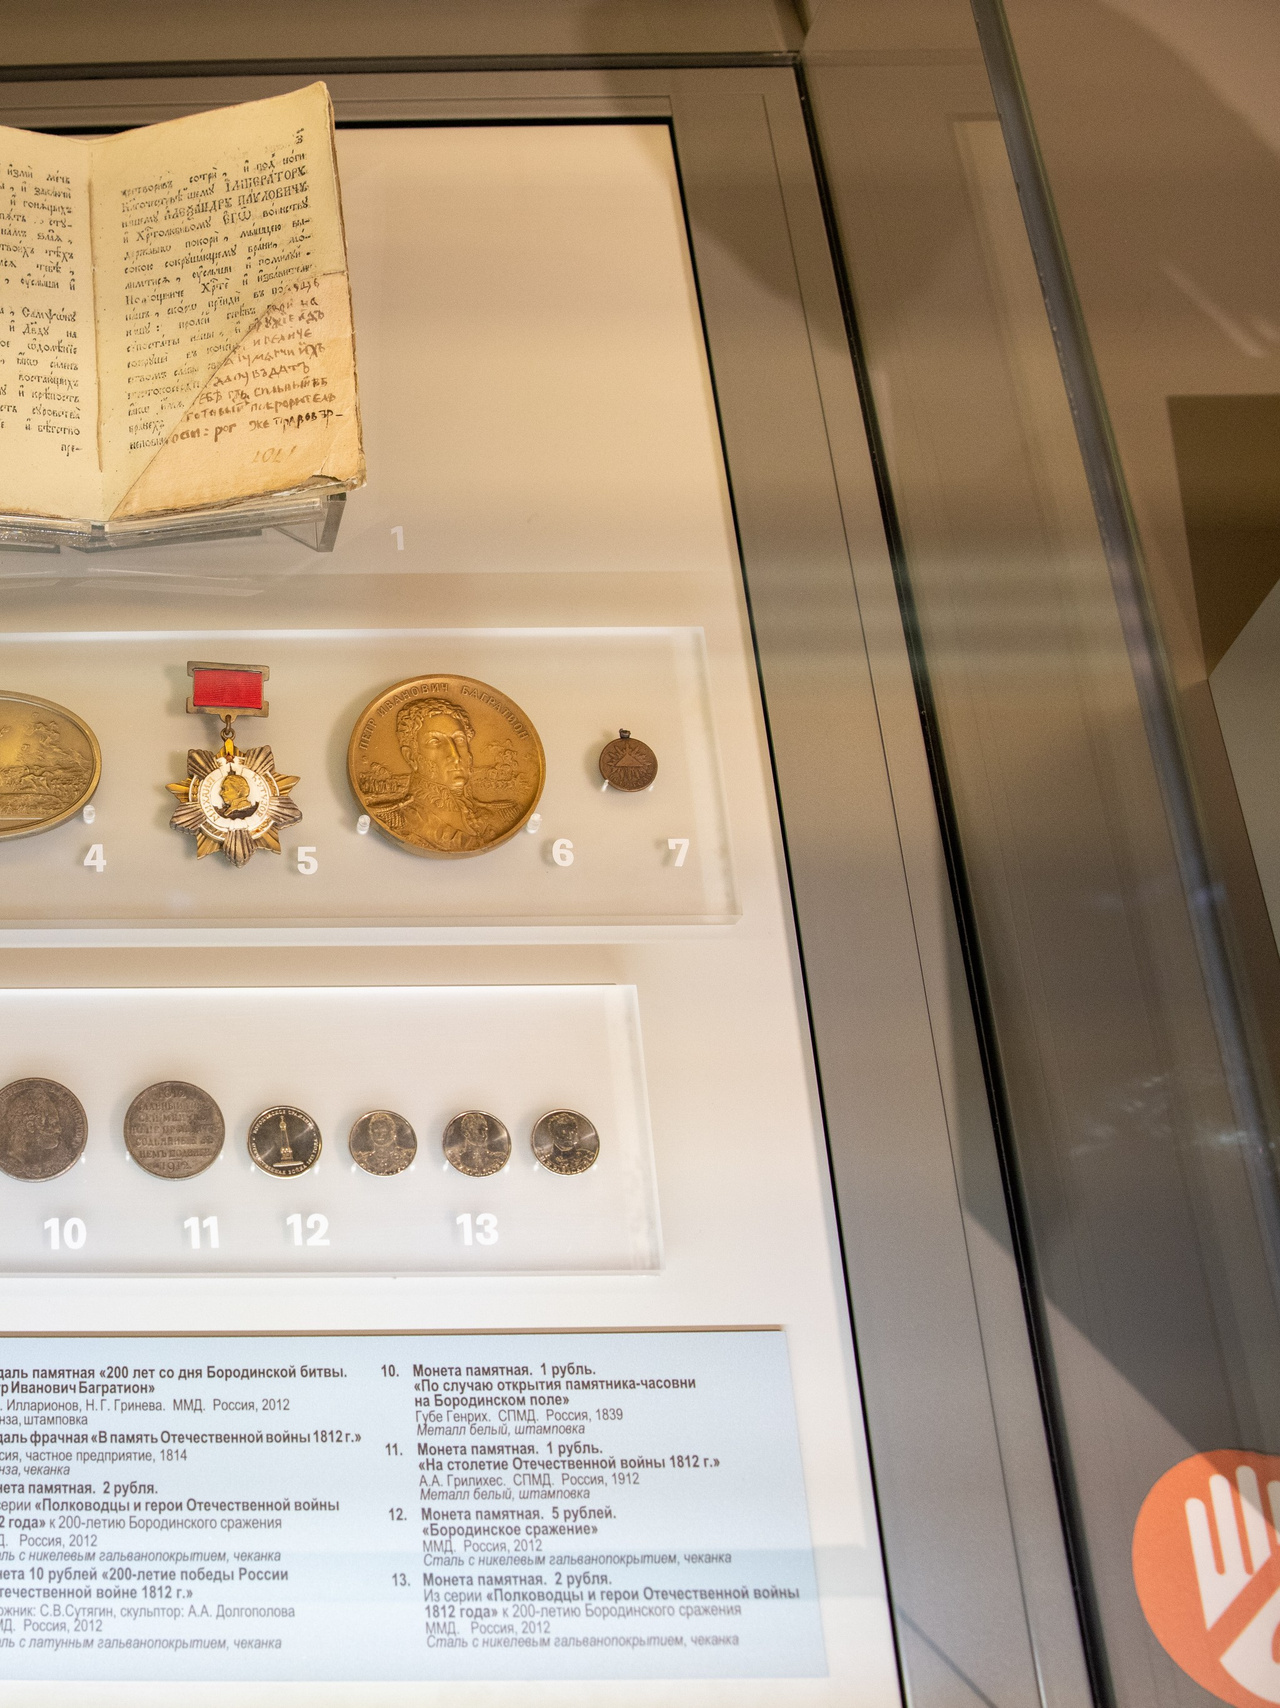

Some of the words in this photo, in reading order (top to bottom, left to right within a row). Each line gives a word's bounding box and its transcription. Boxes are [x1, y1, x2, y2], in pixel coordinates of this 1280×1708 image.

[391, 526, 404, 550] 1
[359, 718, 377, 750] ПЕТР
[378, 682, 449, 717] ИВАНОВИЧ
[461, 685, 529, 741] БАГРАТИОН
[84, 844, 106, 872] 4
[298, 847, 318, 874] 5
[553, 839, 574, 866] 6
[668, 839, 689, 866] 7
[45, 1218, 86, 1249] 10
[184, 1216, 219, 1249] 11
[287, 1214, 330, 1246] 12
[457, 1213, 498, 1245] 13
[32, 1368, 95, 1379] памятная
[99, 1365, 129, 1379] «200
[132, 1368, 156, 1379] лет
[158, 1368, 175, 1379] со
[177, 1368, 203, 1381] дня
[206, 1365, 297, 1382] Бородинской
[300, 1364, 347, 1378] битвы.
[381, 1364, 400, 1378] 10.
[412, 1363, 462, 1377] Монета
[465, 1365, 533, 1377] памятная.
[540, 1362, 547, 1376] 1
[551, 1361, 596, 1379] рубль.
[11, 1380, 77, 1394] Иванович
[78, 1380, 155, 1397] Багратион»
[413, 1378, 440, 1392] «По
[442, 1381, 494, 1395] случаю
[497, 1380, 562, 1394] открытия
[565, 1378, 696, 1390] памятника-часовни
[414, 1396, 431, 1407] на
[434, 1393, 526, 1410] Бородинском
[529, 1395, 570, 1406] поле»
[25, 1451, 73, 1462] частное
[76, 1451, 156, 1465] предприятие,
[160, 1448, 188, 1462] 1814
[385, 1442, 403, 1456] 11.
[417, 1442, 467, 1456] Монета
[470, 1444, 539, 1455] памятная.
[546, 1441, 553, 1454] 1
[558, 1440, 603, 1458] рубль.
[23, 1465, 71, 1476] чеканка
[418, 1457, 444, 1471] «На
[447, 1460, 509, 1471] столетие
[512, 1455, 617, 1471] Отечественной
[620, 1455, 666, 1469] войны
[669, 1454, 700, 1469] 1812
[703, 1457, 721, 1468] г.»
[28, 1483, 96, 1494] памятная.
[103, 1480, 111, 1494] 2
[113, 1480, 158, 1498] рубля.
[388, 1507, 407, 1521] 12.
[421, 1507, 472, 1521] Монета
[475, 1509, 544, 1521] памятная.
[552, 1506, 560, 1520] 5
[563, 1505, 617, 1523] рублей.
[422, 1522, 521, 1539] «Бородинское
[524, 1523, 598, 1538] сражение»
[29, 1566, 44, 1581] 10
[48, 1566, 97, 1584] рублей
[101, 1566, 176, 1581] «200-летие
[180, 1566, 235, 1583] победы
[238, 1566, 289, 1581] России
[392, 1572, 411, 1587] 13.
[422, 1572, 474, 1587] Монета
[477, 1575, 547, 1586] памятная.
[554, 1571, 563, 1585] 2
[566, 1570, 612, 1589] рубля.
[96, 1585, 138, 1599] войне
[141, 1585, 172, 1599] 1812
[176, 1588, 194, 1599] г.»
